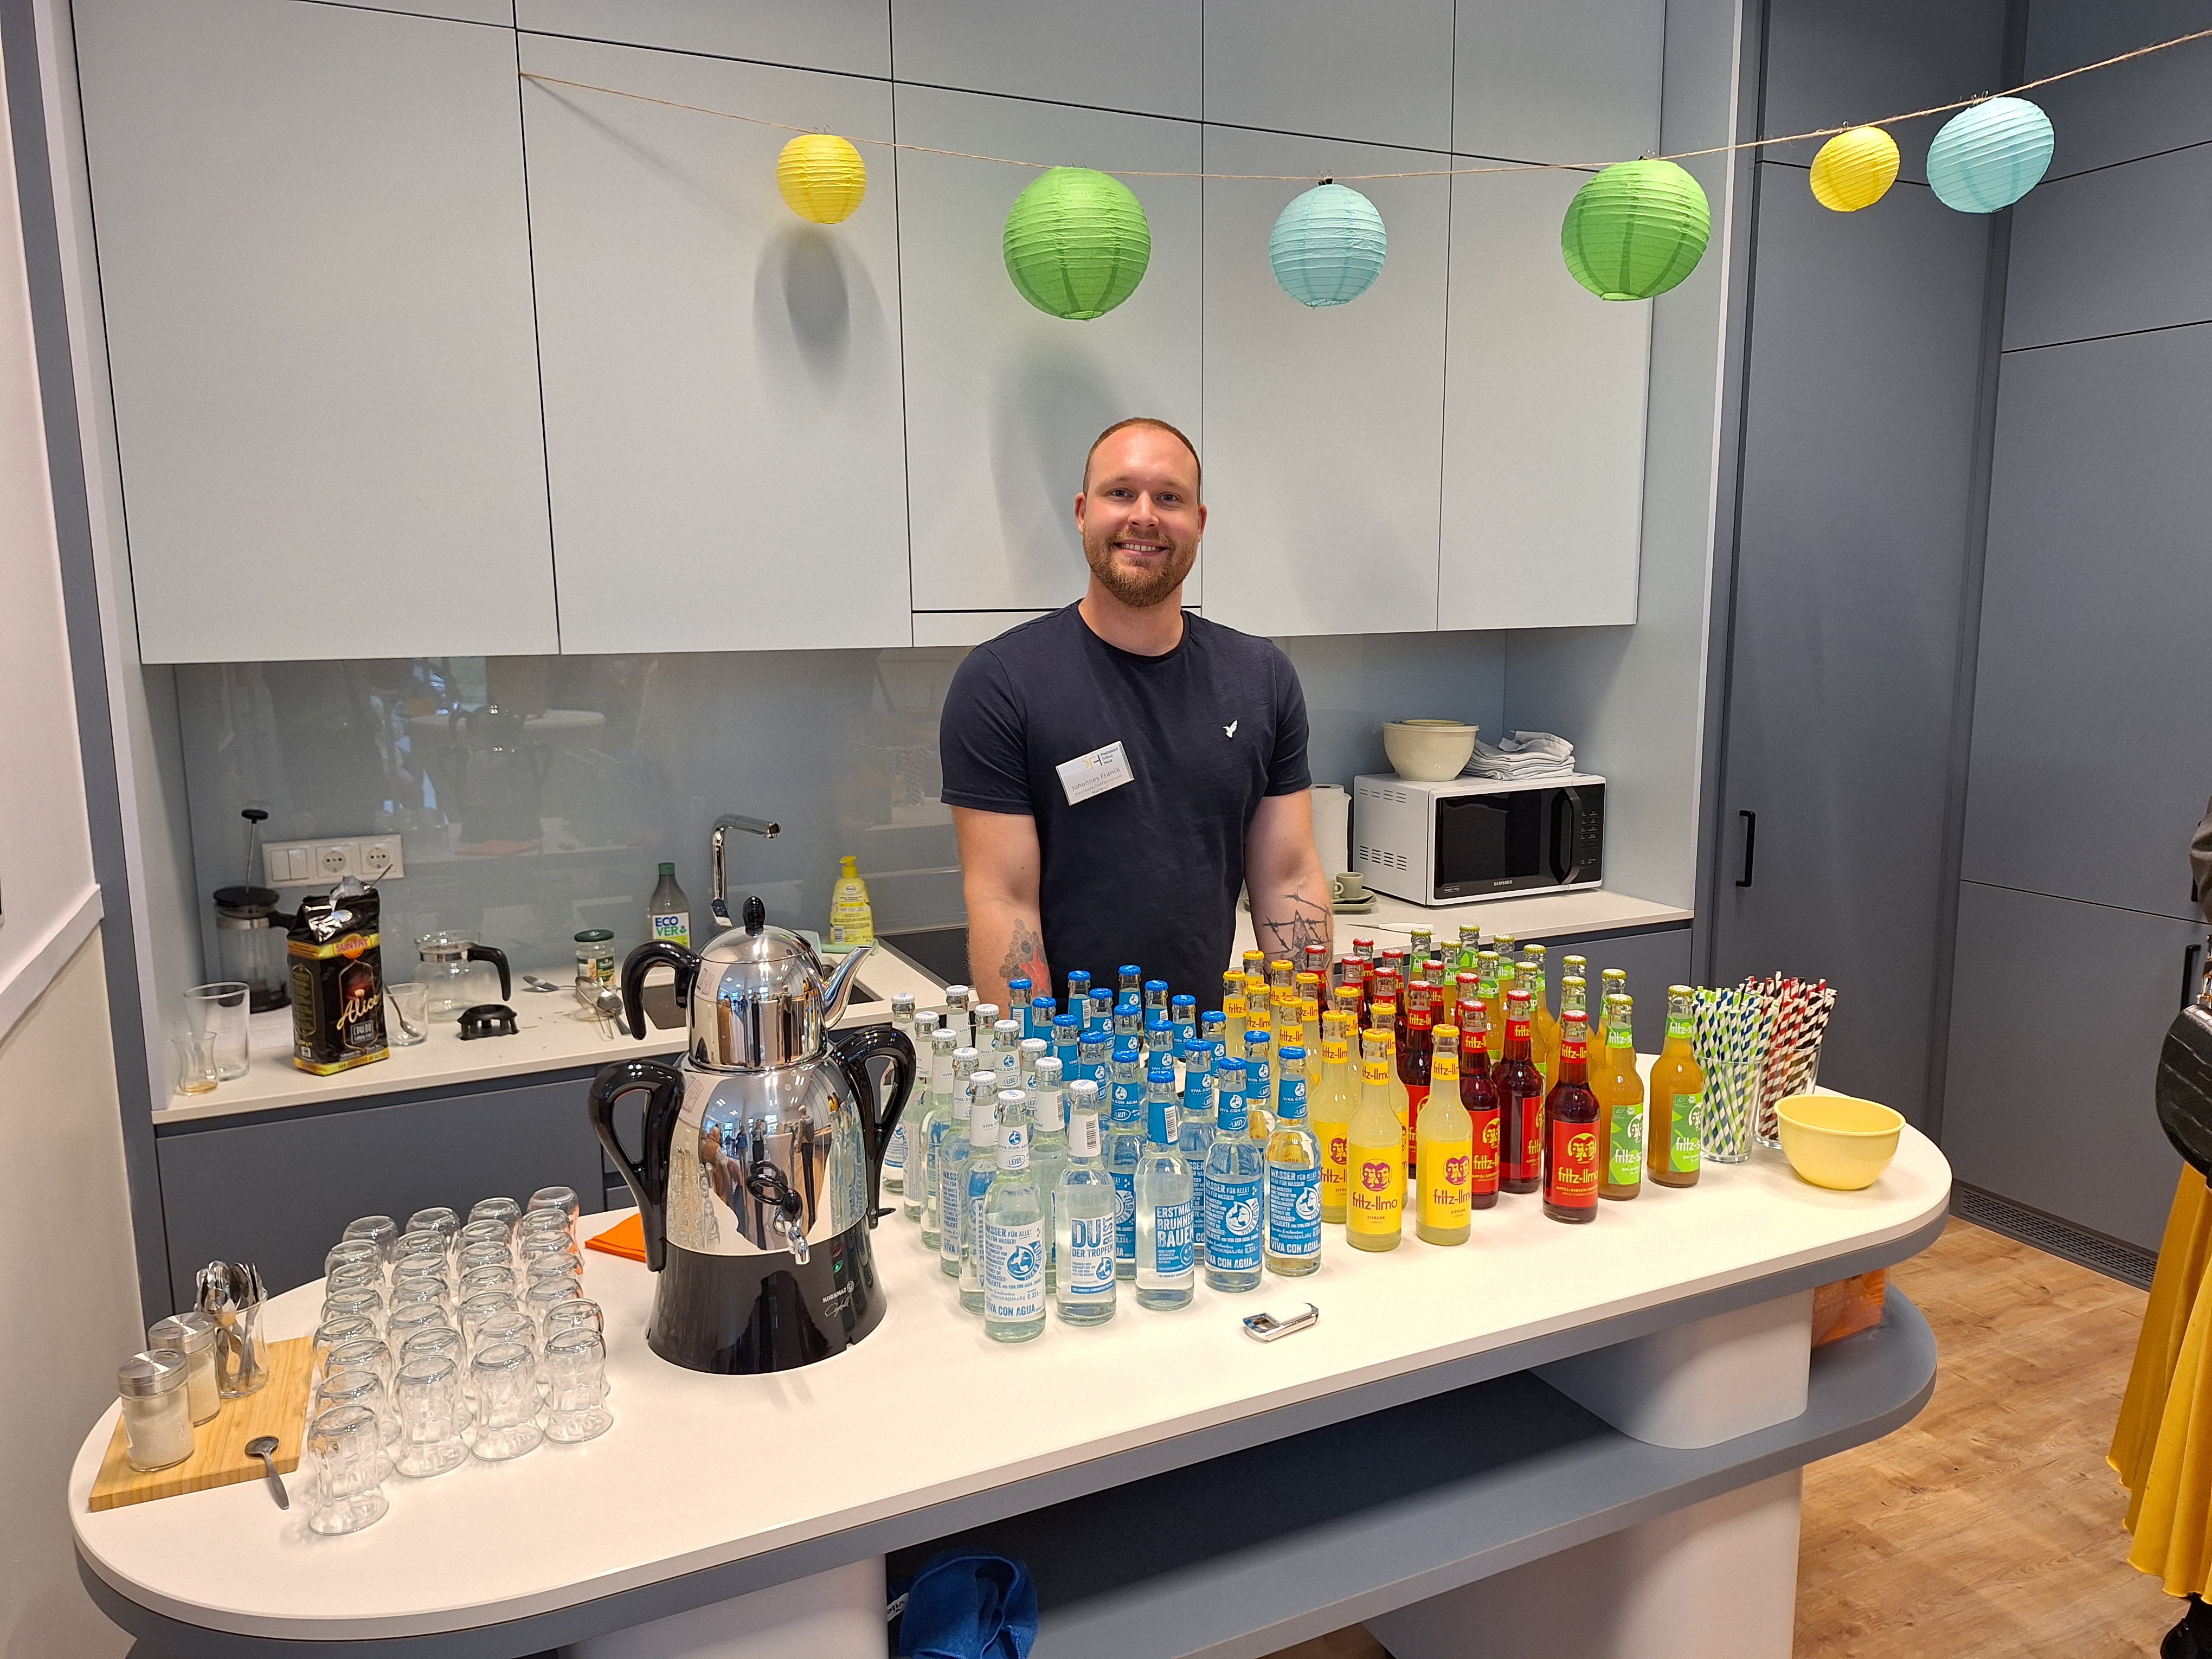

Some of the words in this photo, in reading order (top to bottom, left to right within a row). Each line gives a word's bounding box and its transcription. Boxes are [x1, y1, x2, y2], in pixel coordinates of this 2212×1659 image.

[1072, 776, 1099, 792] Johannes
[1101, 768, 1120, 779] Franck
[1075, 775, 1122, 795] Nachbarschaftszentrum
[655, 916, 679, 927] ECO
[656, 926, 679, 936] VER
[335, 938, 369, 953] SUNTAT
[1229, 1003, 1246, 1013] fritz-l
[1675, 1137, 1700, 1151] fritz-s
[943, 1170, 957, 1181] WASS
[1271, 1168, 1296, 1181] WASSER
[1321, 1167, 1347, 1183] fritz-l
[1558, 1166, 1598, 1184] fritz-limo
[1353, 1191, 1398, 1210] fritz-limo
[1433, 1188, 1471, 1205] fritz-lim
[1072, 1219, 1101, 1248] DU
[1103, 1216, 1113, 1245] BIST
[1072, 1249, 1085, 1258] DER
[1087, 1243, 1113, 1258] TROPFEN
[1271, 1238, 1285, 1252] VIVA
[1287, 1244, 1302, 1253] CON
[1303, 1239, 1319, 1253] AGUA
[1217, 1257, 1232, 1268] CON
[1234, 1257, 1253, 1269] AGUA
[822, 1287, 847, 1303] KORKMAZ
[998, 1306, 1013, 1316] CON
[1016, 1303, 1036, 1316] AGUA
